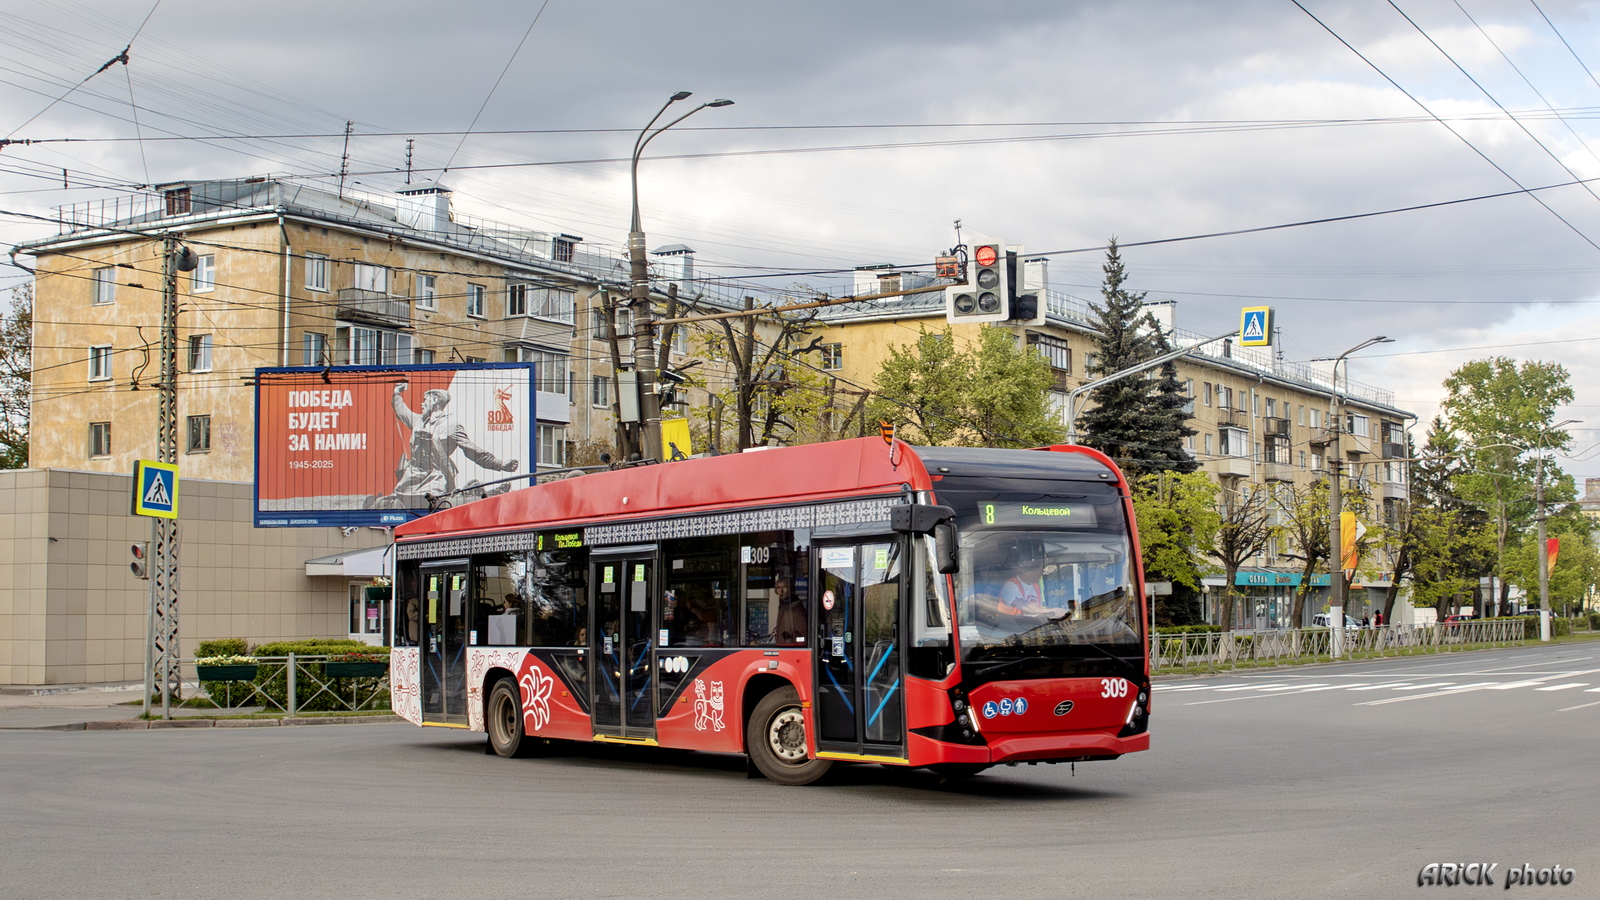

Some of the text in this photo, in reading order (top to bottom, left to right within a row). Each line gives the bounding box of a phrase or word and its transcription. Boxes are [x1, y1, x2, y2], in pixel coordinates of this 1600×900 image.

[288, 390, 353, 410] ПОБЕДА
[288, 411, 339, 432] БУДЕТ
[487, 410, 502, 424] 80
[487, 424, 514, 432] ПОБЕДА!
[288, 433, 367, 451] ЗА НАМИ!
[288, 460, 334, 469] 1945-2025
[985, 504, 995, 525] 8
[1022, 505, 1071, 516] Кольцевой
[538, 535, 544, 551] 8
[750, 546, 770, 564] 309
[1249, 574, 1269, 584] ОБУВЬ
[1101, 678, 1128, 698] 309
